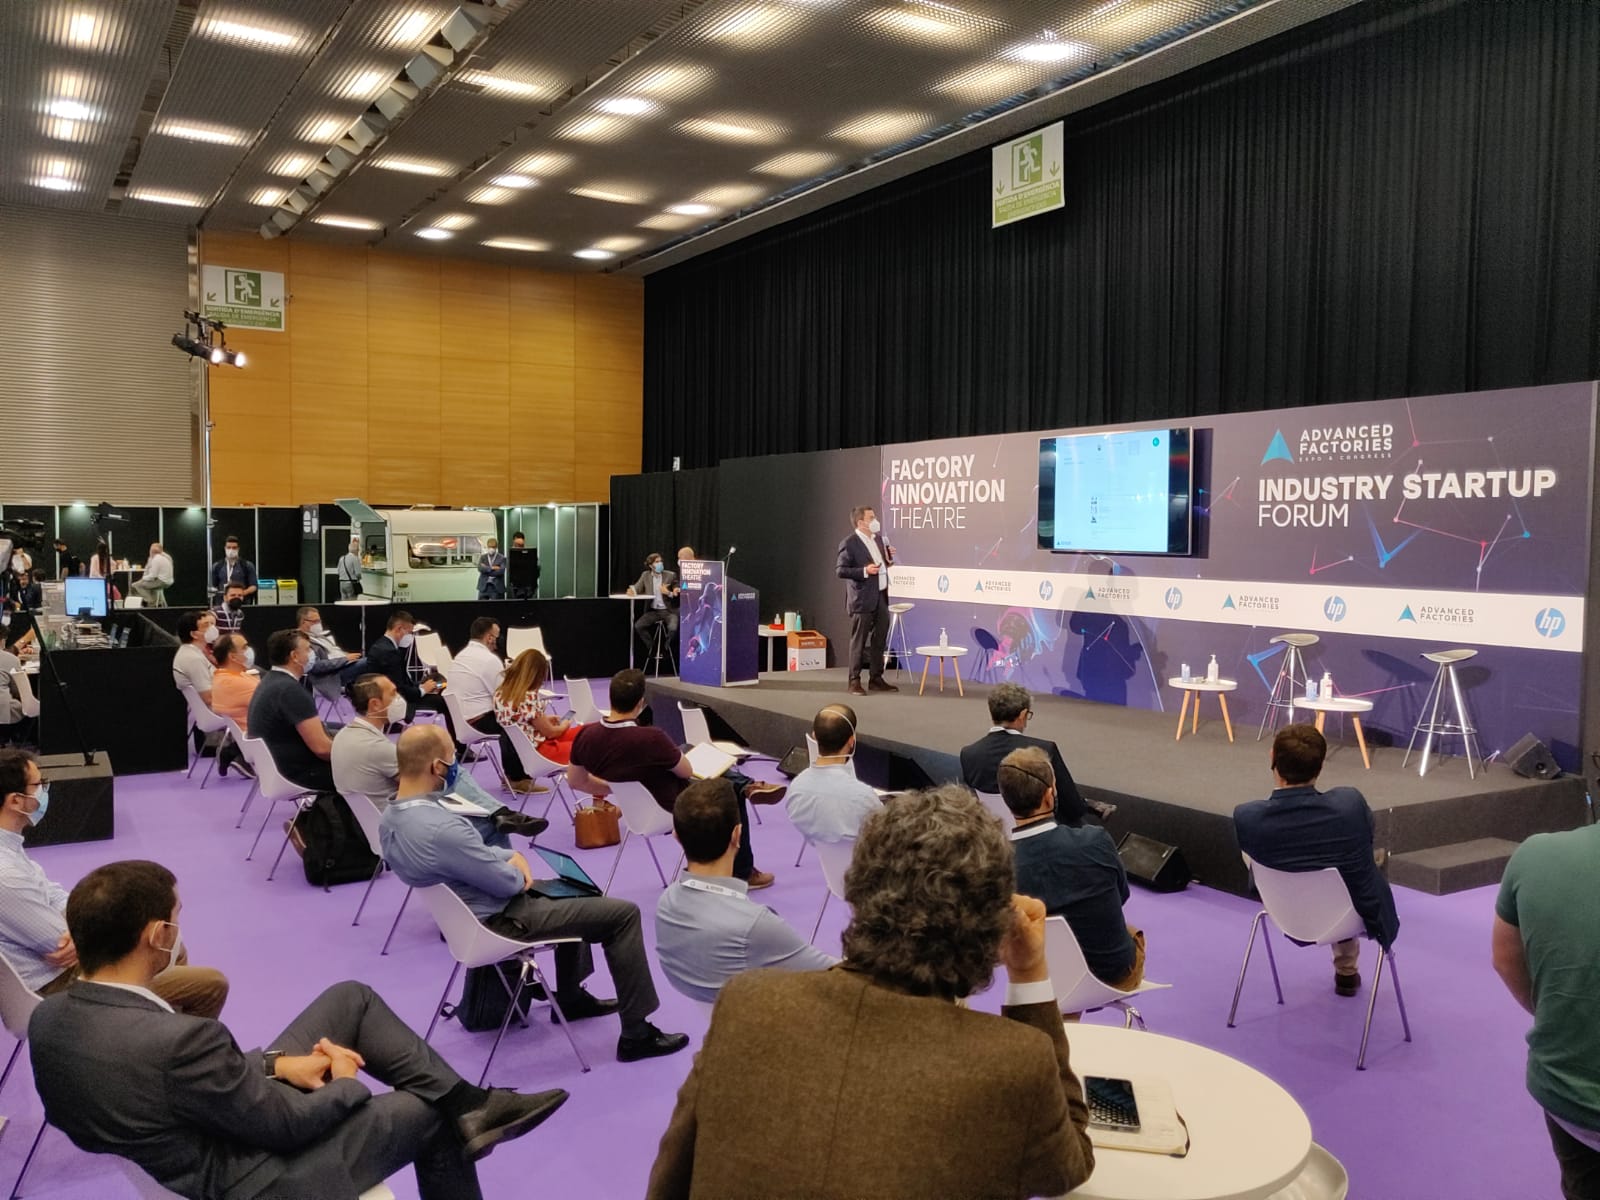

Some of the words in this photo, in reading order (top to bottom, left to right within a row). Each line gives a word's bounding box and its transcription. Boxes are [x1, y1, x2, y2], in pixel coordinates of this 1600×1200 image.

[1300, 424, 1394, 442] ADVANCED
[1299, 438, 1393, 455] FACTORIES
[1340, 453, 1392, 461] CONGRESS
[891, 454, 975, 481] FACTORY
[890, 478, 1005, 505] INNOVATION
[1258, 475, 1394, 501] INDUSTRY
[1402, 469, 1557, 499] STARTUP
[890, 506, 966, 529] THEATRE
[1258, 503, 1349, 527] FORUM
[1166, 587, 1181, 610] hp
[1238, 602, 1280, 610] FACTORIES
[1239, 595, 1280, 603] ADVANCED
[1326, 596, 1345, 622] hp
[1420, 606, 1474, 616] ADVANCED
[1420, 613, 1474, 623] FACTORIES
[1538, 608, 1562, 638] hp
